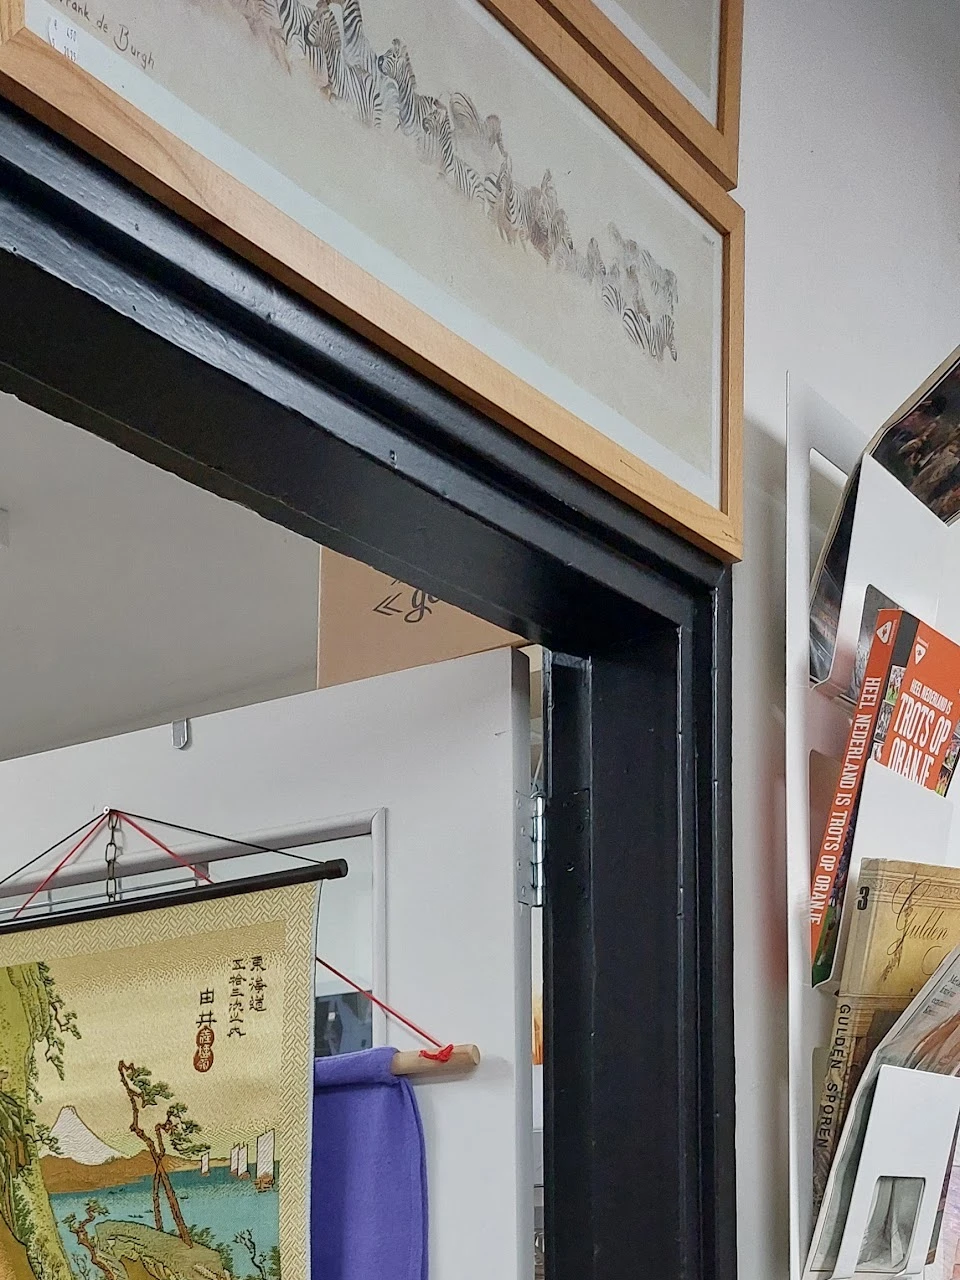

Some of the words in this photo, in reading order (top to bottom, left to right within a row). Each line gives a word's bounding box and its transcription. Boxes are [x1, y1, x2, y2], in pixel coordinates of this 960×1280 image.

[96, 14, 108, 33] de
[113, 23, 156, 70] Burgh
[858, 677, 882, 710] HEEL
[894, 692, 934, 748] TROTS
[932, 716, 952, 756] OP
[839, 713, 872, 790] NEDERLAND
[835, 791, 849, 808] IS
[824, 810, 848, 853] TROTS
[820, 854, 837, 874] OP
[857, 886, 870, 911] 3
[887, 878, 949, 956] Gulden
[195, 986, 218, 1029] 由井
[829, 1004, 851, 1069] GULDEN
[818, 1082, 838, 1149] SPOREN
